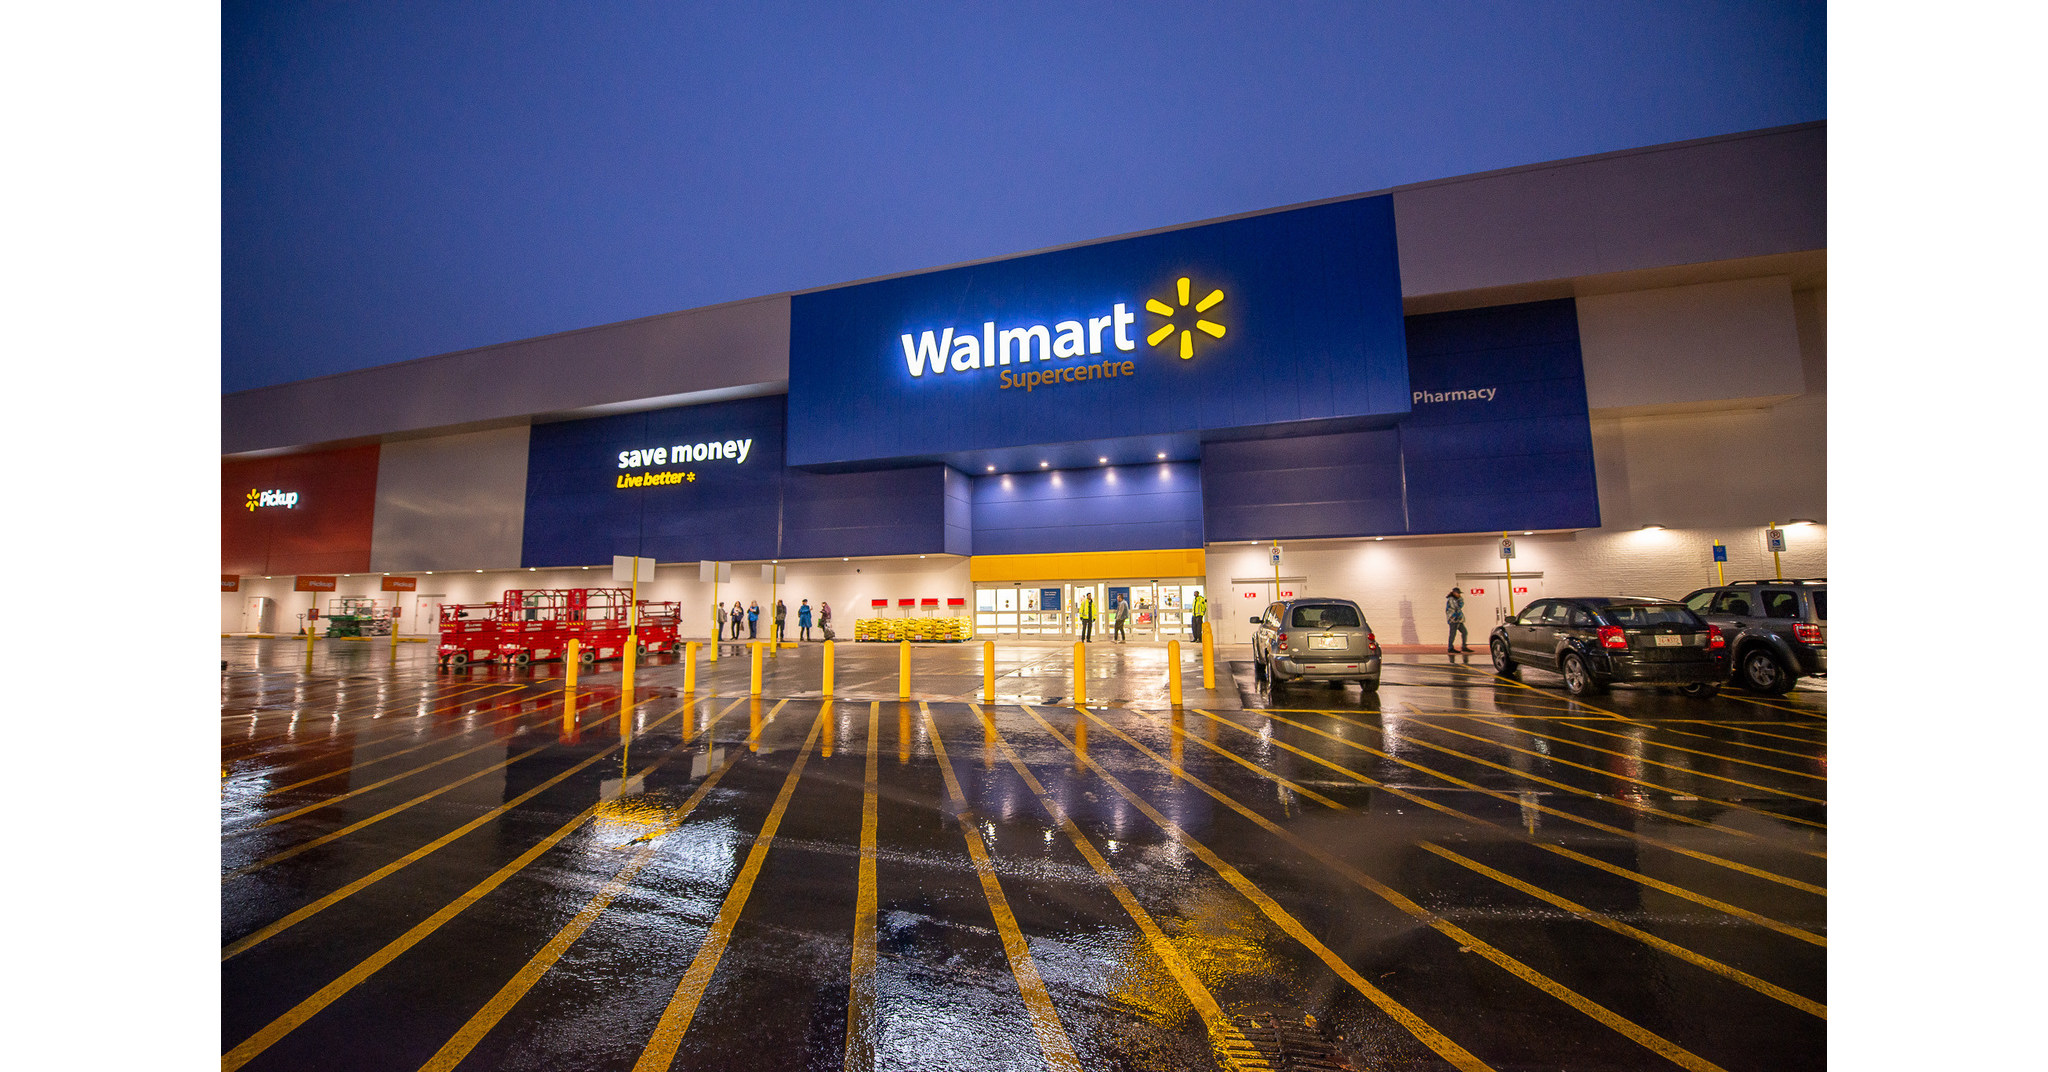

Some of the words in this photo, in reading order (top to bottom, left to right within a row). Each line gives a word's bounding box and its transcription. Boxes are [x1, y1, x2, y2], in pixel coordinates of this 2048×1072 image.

[901, 302, 1135, 377] Walmart
[1000, 360, 1135, 392] Supercentre
[1413, 387, 1497, 405] Pharmacy
[618, 447, 667, 469] save
[671, 438, 752, 464] money
[616, 473, 643, 488] Live
[643, 471, 685, 487] better
[260, 489, 299, 509] Pickup
